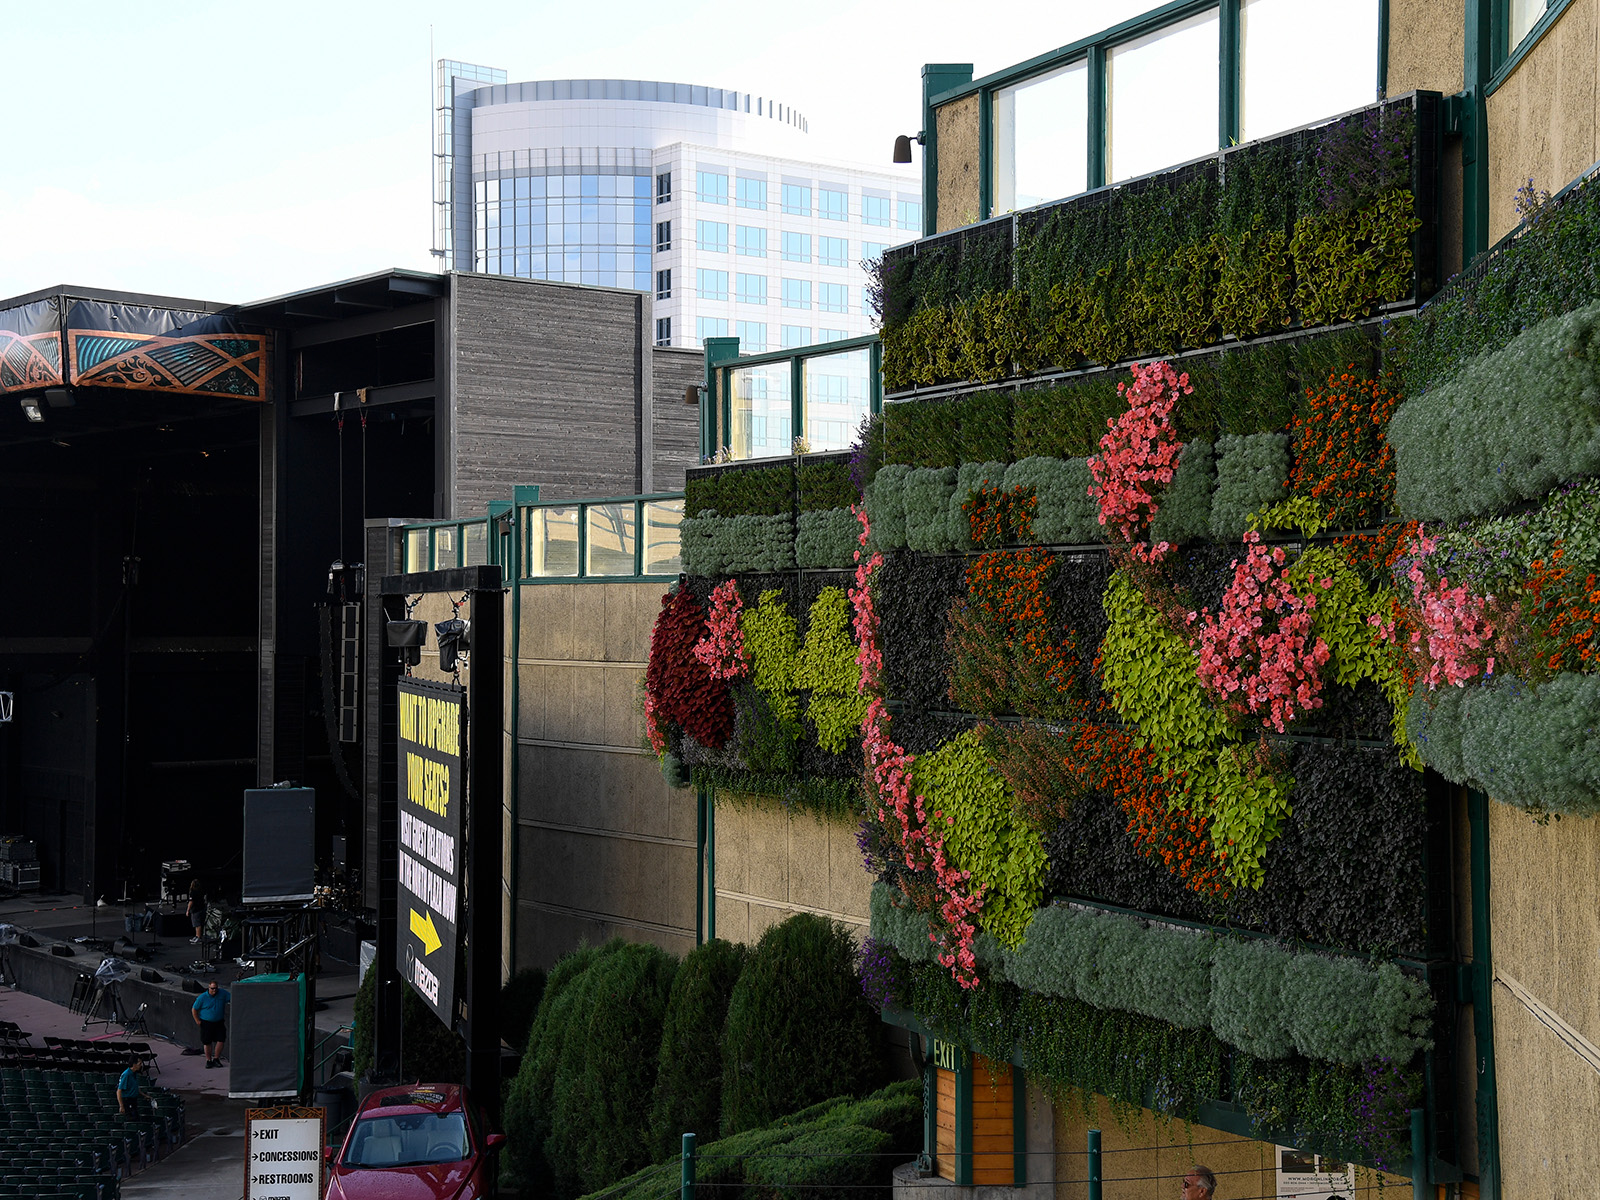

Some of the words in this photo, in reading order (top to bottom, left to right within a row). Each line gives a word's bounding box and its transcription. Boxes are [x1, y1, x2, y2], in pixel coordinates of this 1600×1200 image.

[399, 691, 418, 743] WANT
[418, 696, 427, 747] TO
[427, 697, 460, 758] UPGRADE
[407, 751, 424, 807] YOUR
[424, 758, 450, 818] SEATS?
[934, 1039, 956, 1071] EXIT
[259, 1129, 279, 1140] EXIT
[259, 1150, 319, 1162] CONCESSIONS
[258, 1173, 314, 1185] RESTROOMS
